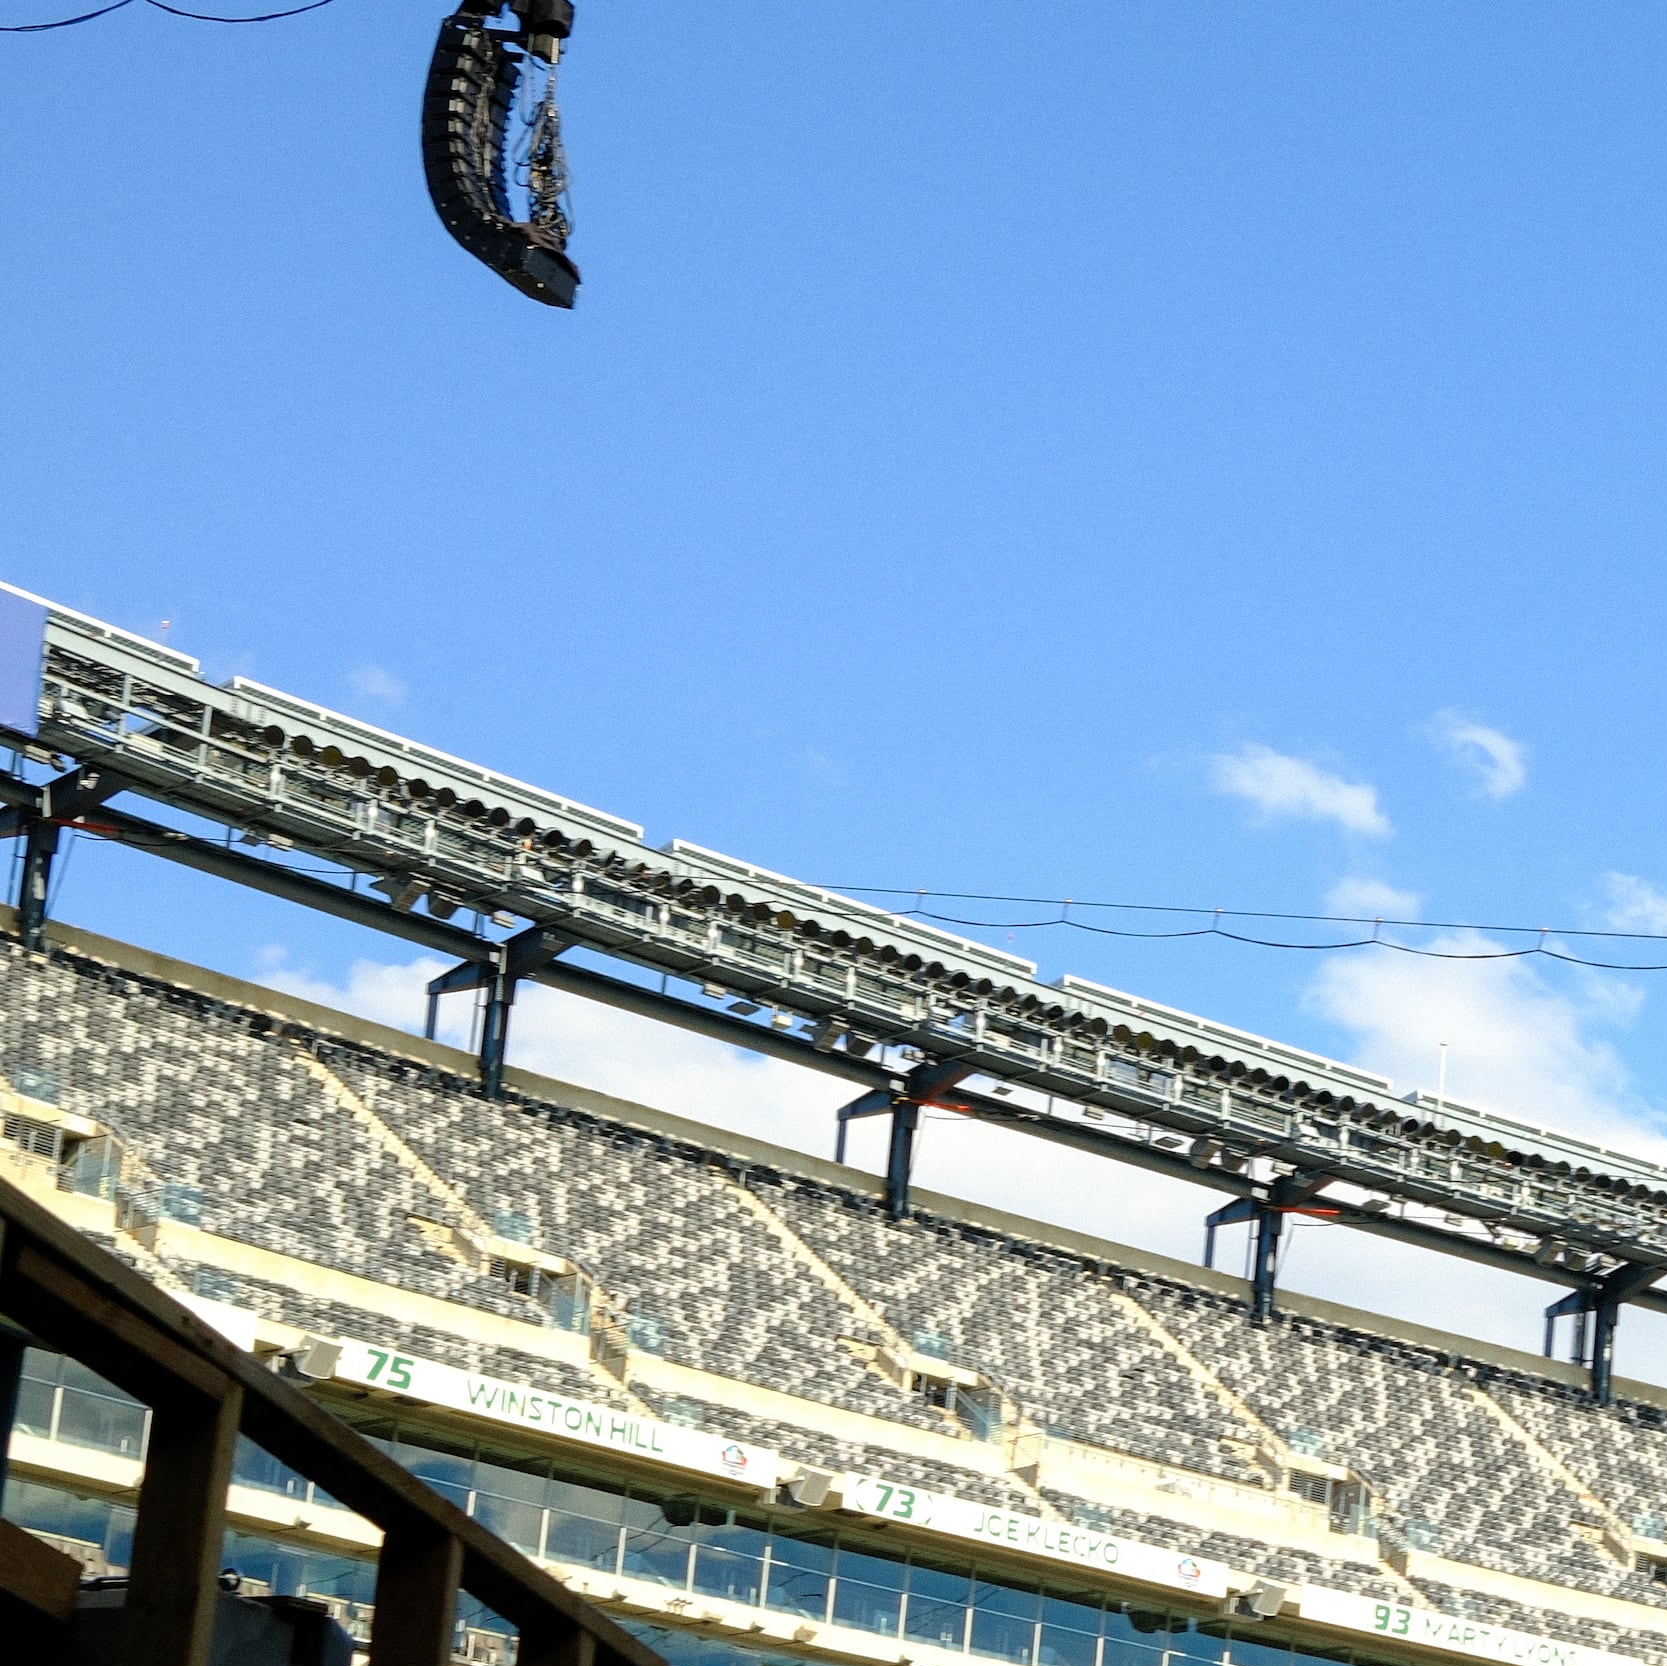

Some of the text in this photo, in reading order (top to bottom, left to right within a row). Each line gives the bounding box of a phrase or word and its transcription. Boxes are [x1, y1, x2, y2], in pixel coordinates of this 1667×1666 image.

[365, 1348, 665, 1454] 75 WINSTON HILL
[974, 1511, 1019, 1542] JOE
[1027, 1522, 1119, 1564] KLECKO
[1374, 1603, 1412, 1635] 93
[1424, 1617, 1507, 1654] MARTY
